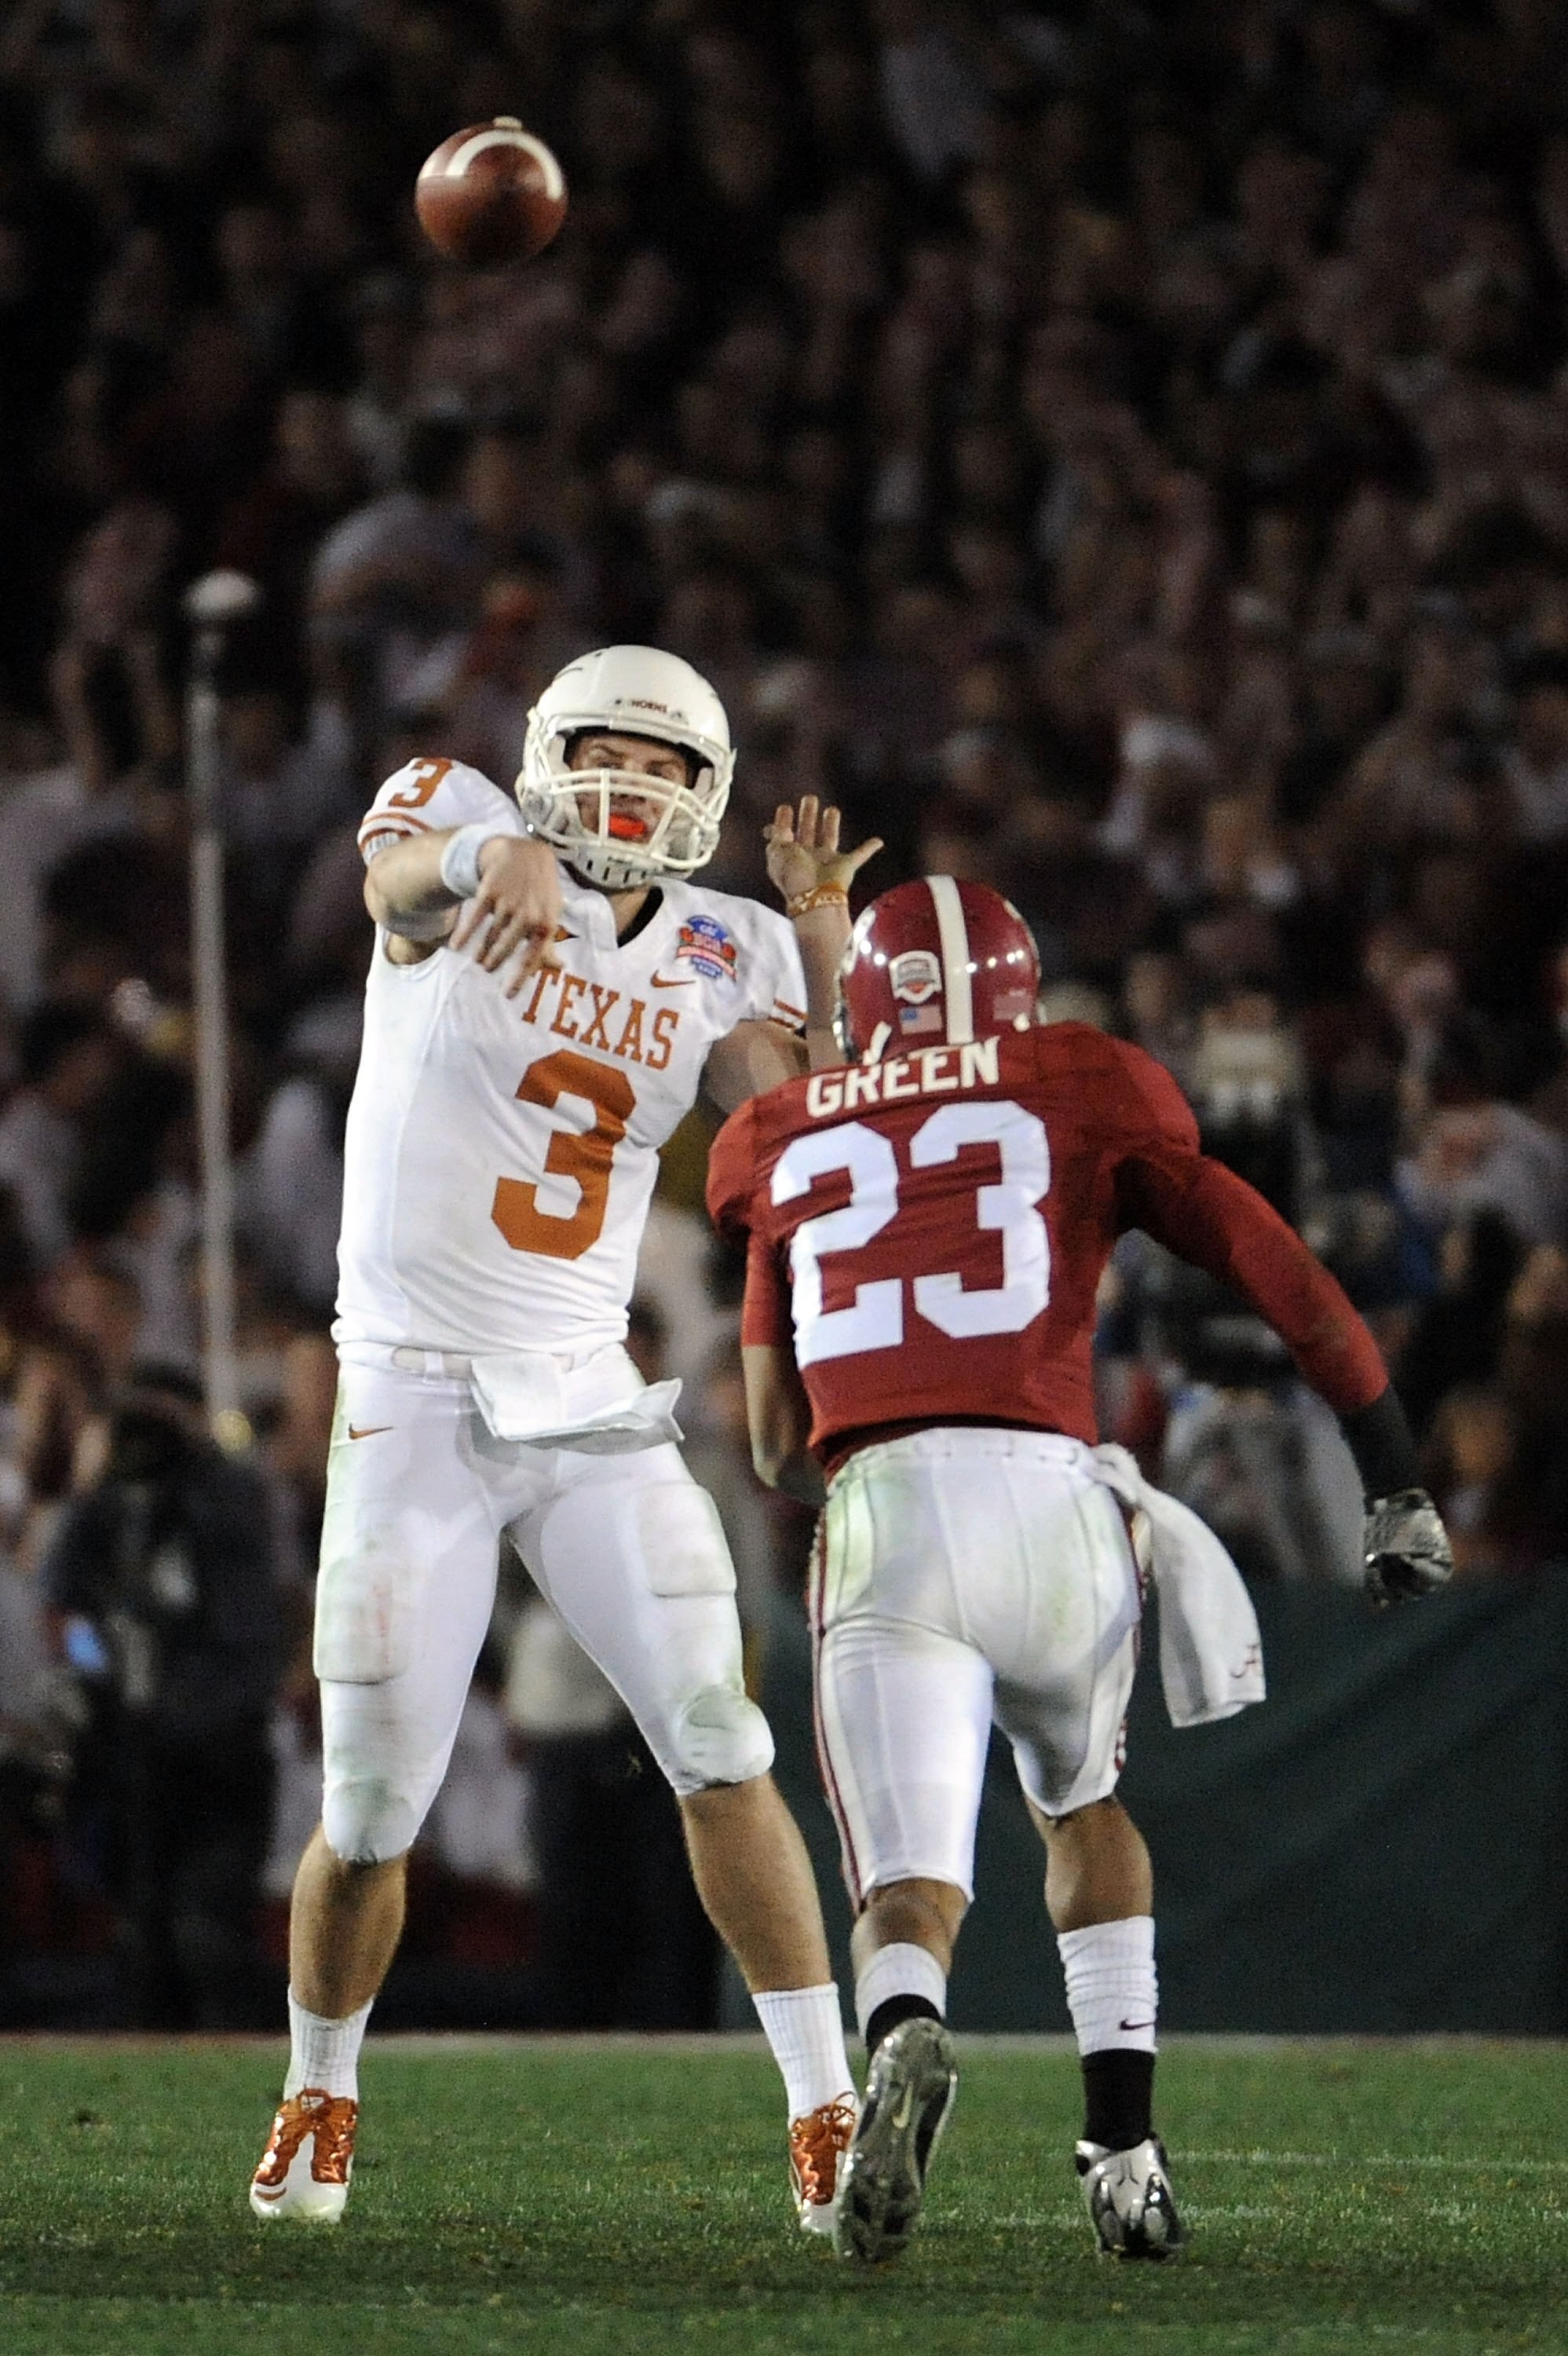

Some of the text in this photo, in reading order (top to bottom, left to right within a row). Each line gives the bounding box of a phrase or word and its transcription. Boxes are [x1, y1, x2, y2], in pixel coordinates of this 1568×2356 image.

[388, 757, 453, 808] 3
[522, 966, 680, 1071] TEXAS
[806, 1036, 1001, 1118] GREEN
[491, 1048, 637, 1261] 3
[770, 1099, 1051, 1371] 23
